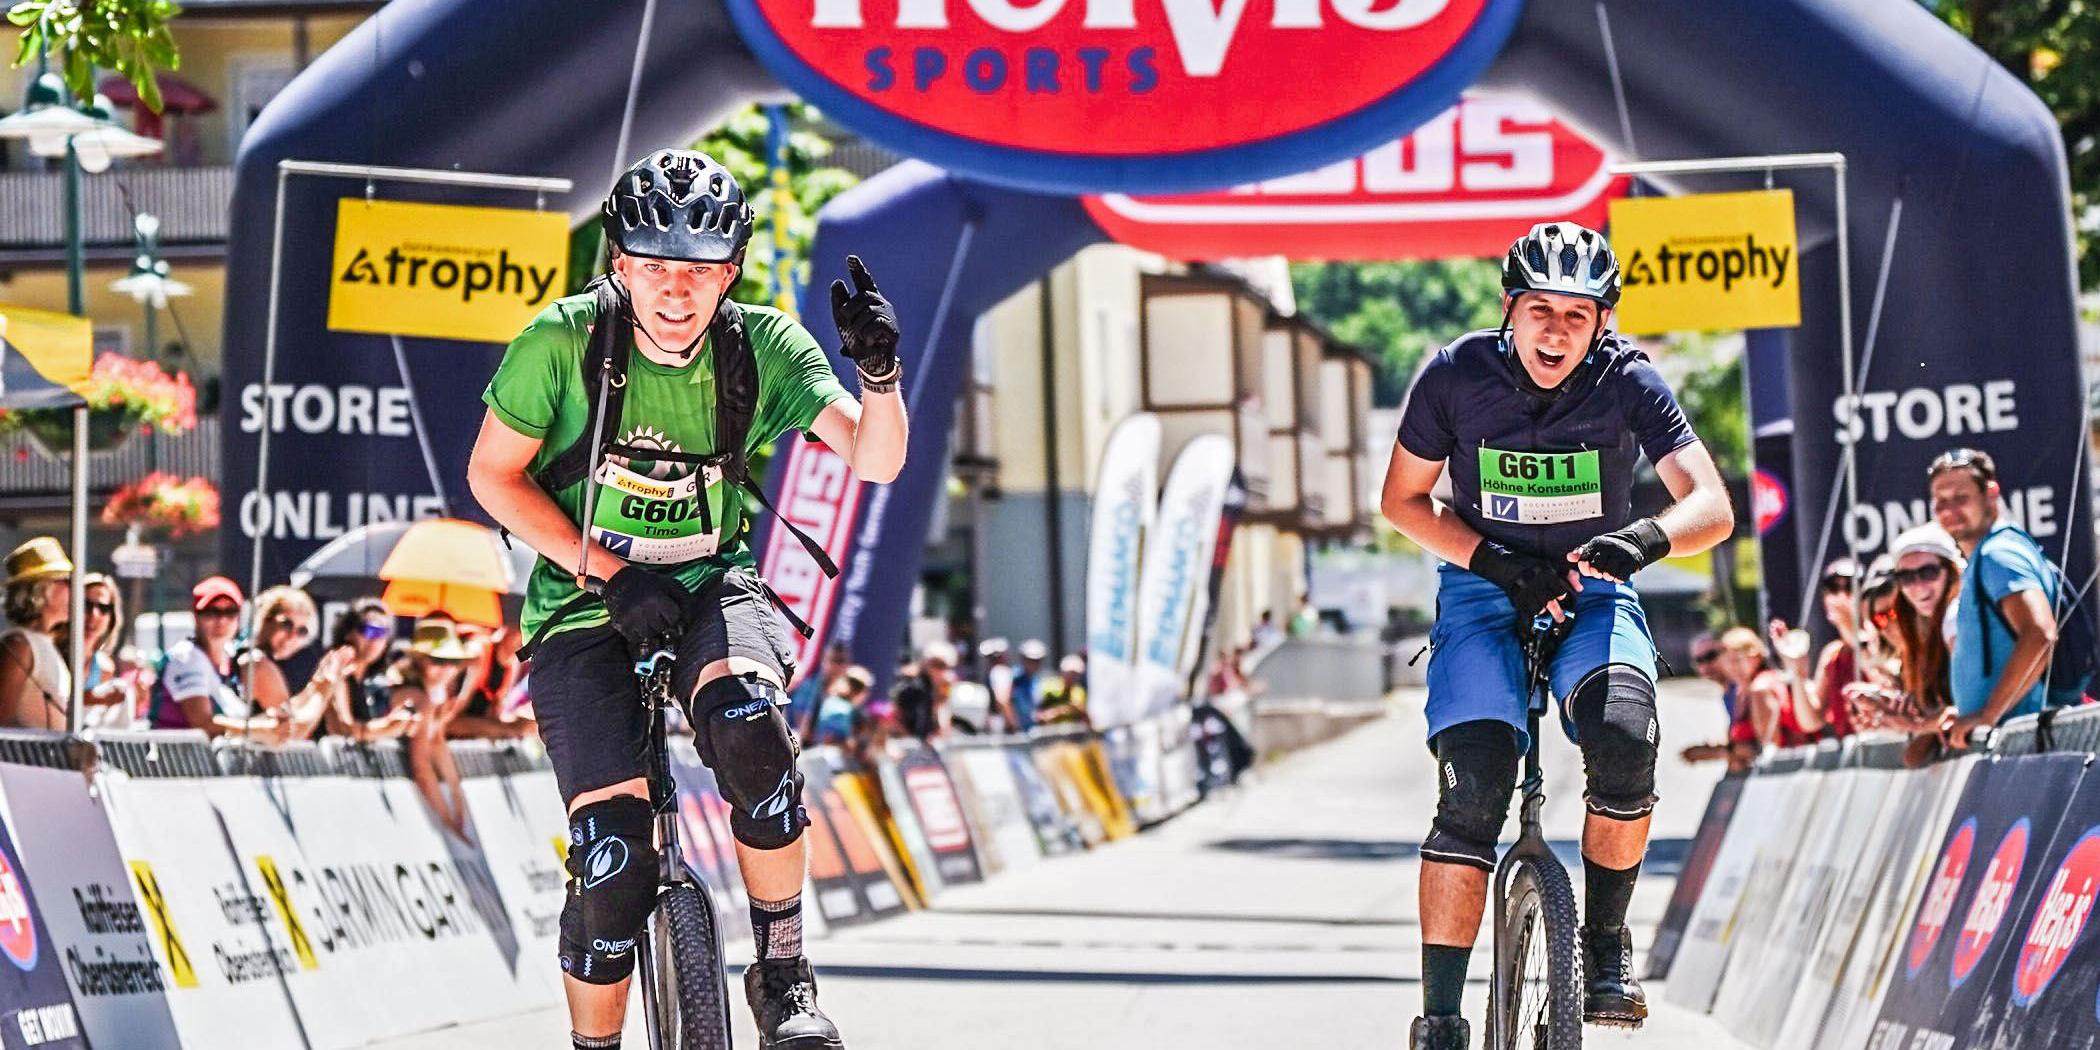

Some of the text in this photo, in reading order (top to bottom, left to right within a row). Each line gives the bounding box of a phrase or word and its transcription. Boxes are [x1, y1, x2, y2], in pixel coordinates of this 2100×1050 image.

[864, 46, 1159, 94] SPORTS
[384, 247, 557, 306] trophy
[1657, 233, 1790, 292] trophy
[240, 383, 412, 437] STORE
[1832, 380, 2018, 445] STORE
[626, 481, 667, 498] trophy
[1483, 478, 1599, 494] Höhne Konstantin
[1498, 452, 1576, 480] G611
[644, 525, 680, 536] Timo
